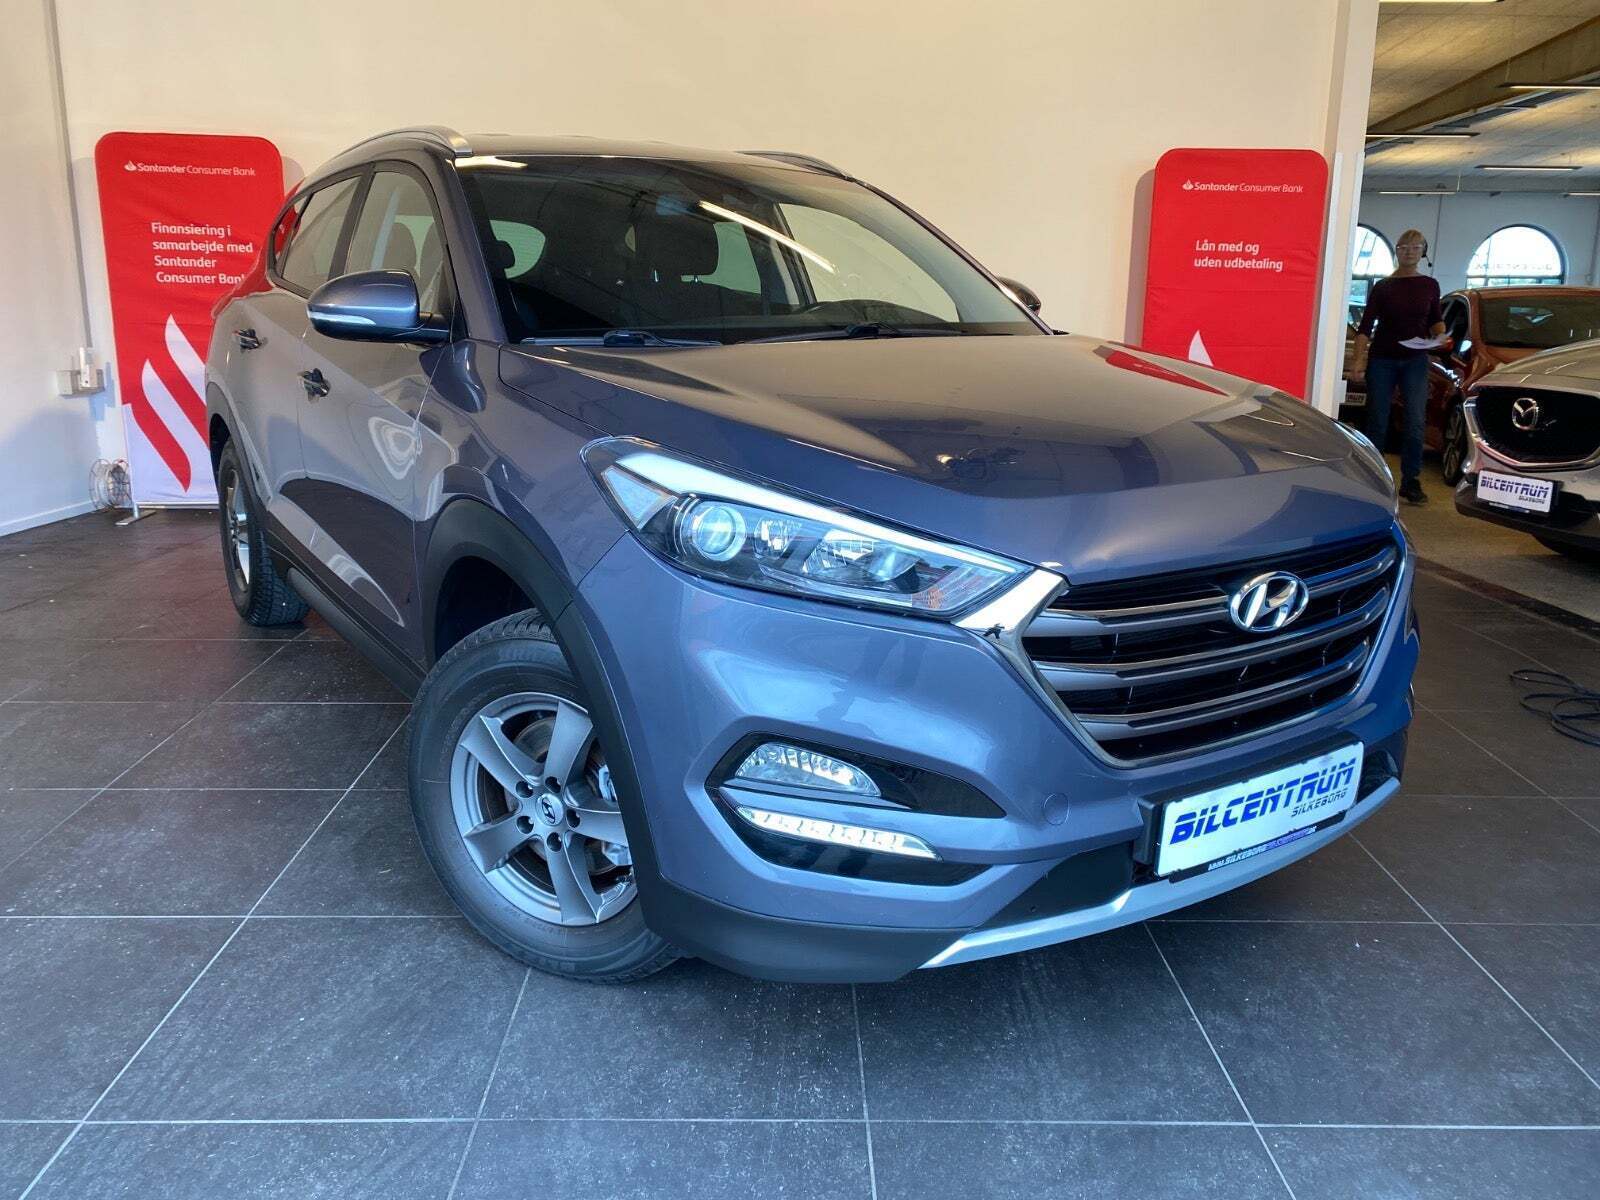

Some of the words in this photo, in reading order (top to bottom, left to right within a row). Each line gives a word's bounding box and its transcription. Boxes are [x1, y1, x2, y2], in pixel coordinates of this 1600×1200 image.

[137, 162, 186, 174] Santander
[187, 165, 232, 175] Consumer
[233, 167, 256, 176] Bank
[1194, 182, 1239, 191] Santander
[1239, 183, 1281, 193] Consumer
[1282, 184, 1303, 193] Bank
[151, 222, 225, 239] Finansiering
[227, 225, 232, 236] i
[152, 240, 224, 254] samarbejde
[227, 242, 253, 253] med
[1196, 239, 1216, 251] Lån
[1218, 241, 1243, 252] med
[1245, 243, 1260, 255] og
[154, 255, 217, 268] Santander
[1194, 257, 1222, 268] uden
[1224, 258, 1283, 272] udbetaling
[156, 272, 216, 284] Consumer
[1480, 475, 1550, 499] BILCENTRUM
[1169, 757, 1356, 845] BILCENTRUM
[1291, 788, 1348, 818] SILKEBORG
